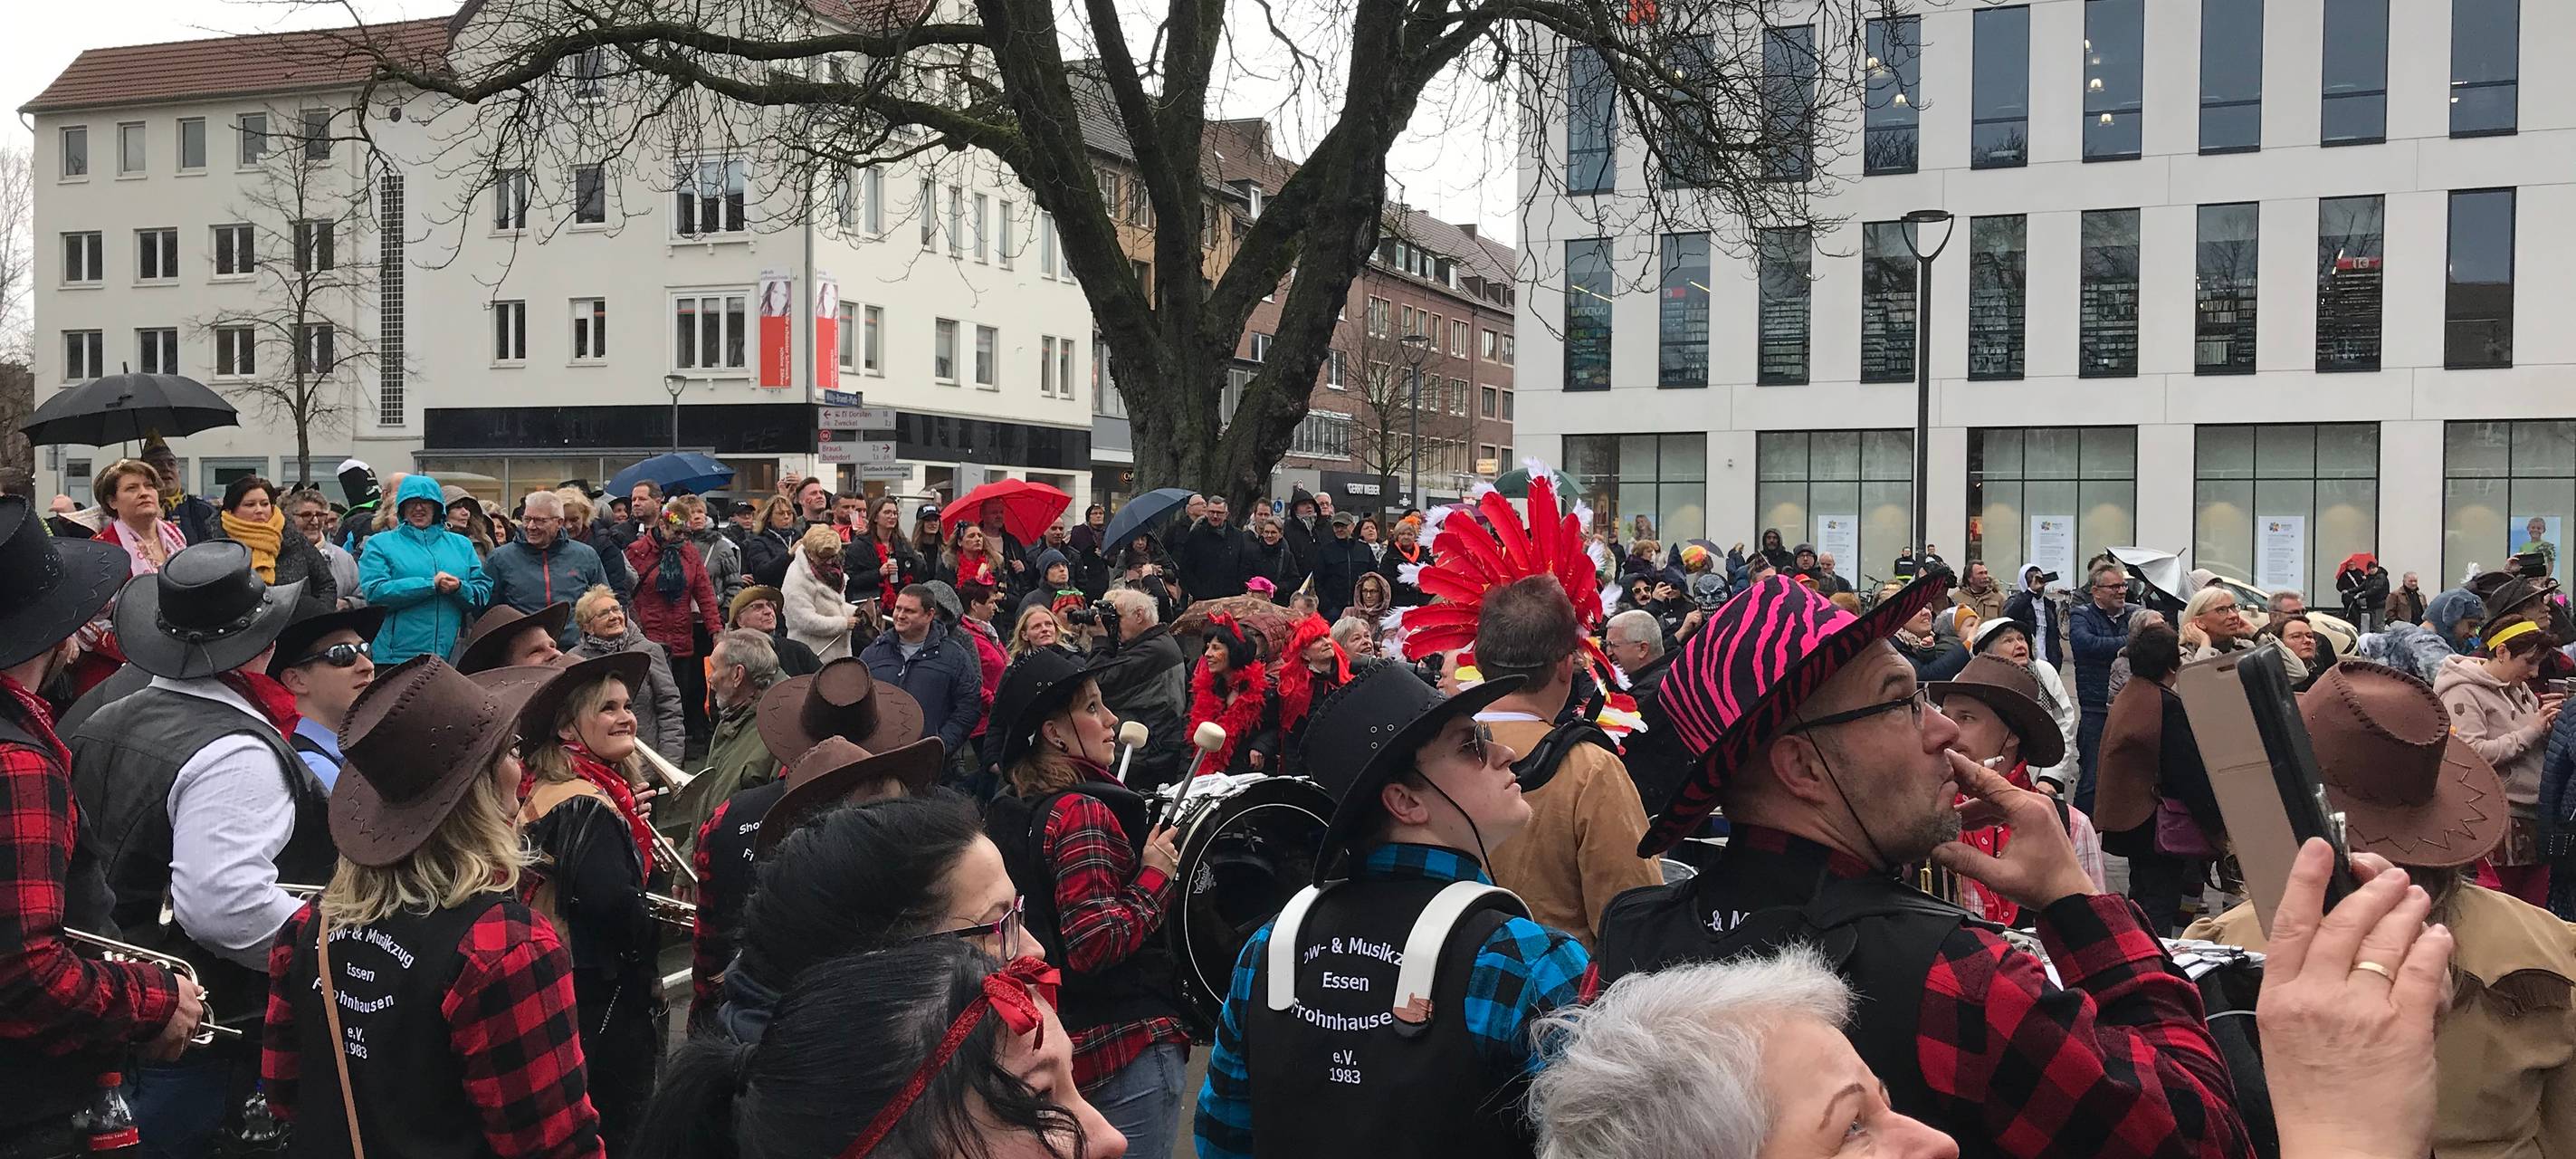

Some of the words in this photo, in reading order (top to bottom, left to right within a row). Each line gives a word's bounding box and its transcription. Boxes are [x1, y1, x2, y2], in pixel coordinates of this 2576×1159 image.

[739, 820, 762, 835] Sho
[365, 928, 415, 969] Musikzug
[1331, 937, 1343, 954] &
[1349, 936, 1404, 966] Musikz
[347, 962, 376, 982] Essen
[1321, 972, 1369, 991] Essen
[312, 977, 395, 1013] Fohnhausen
[1291, 997, 1393, 1031] Frohnhause
[347, 1027, 365, 1042] e.V.
[344, 1041, 368, 1059] 1983
[1332, 1049, 1357, 1066] e.V.
[1329, 1067, 1361, 1085] 1983
